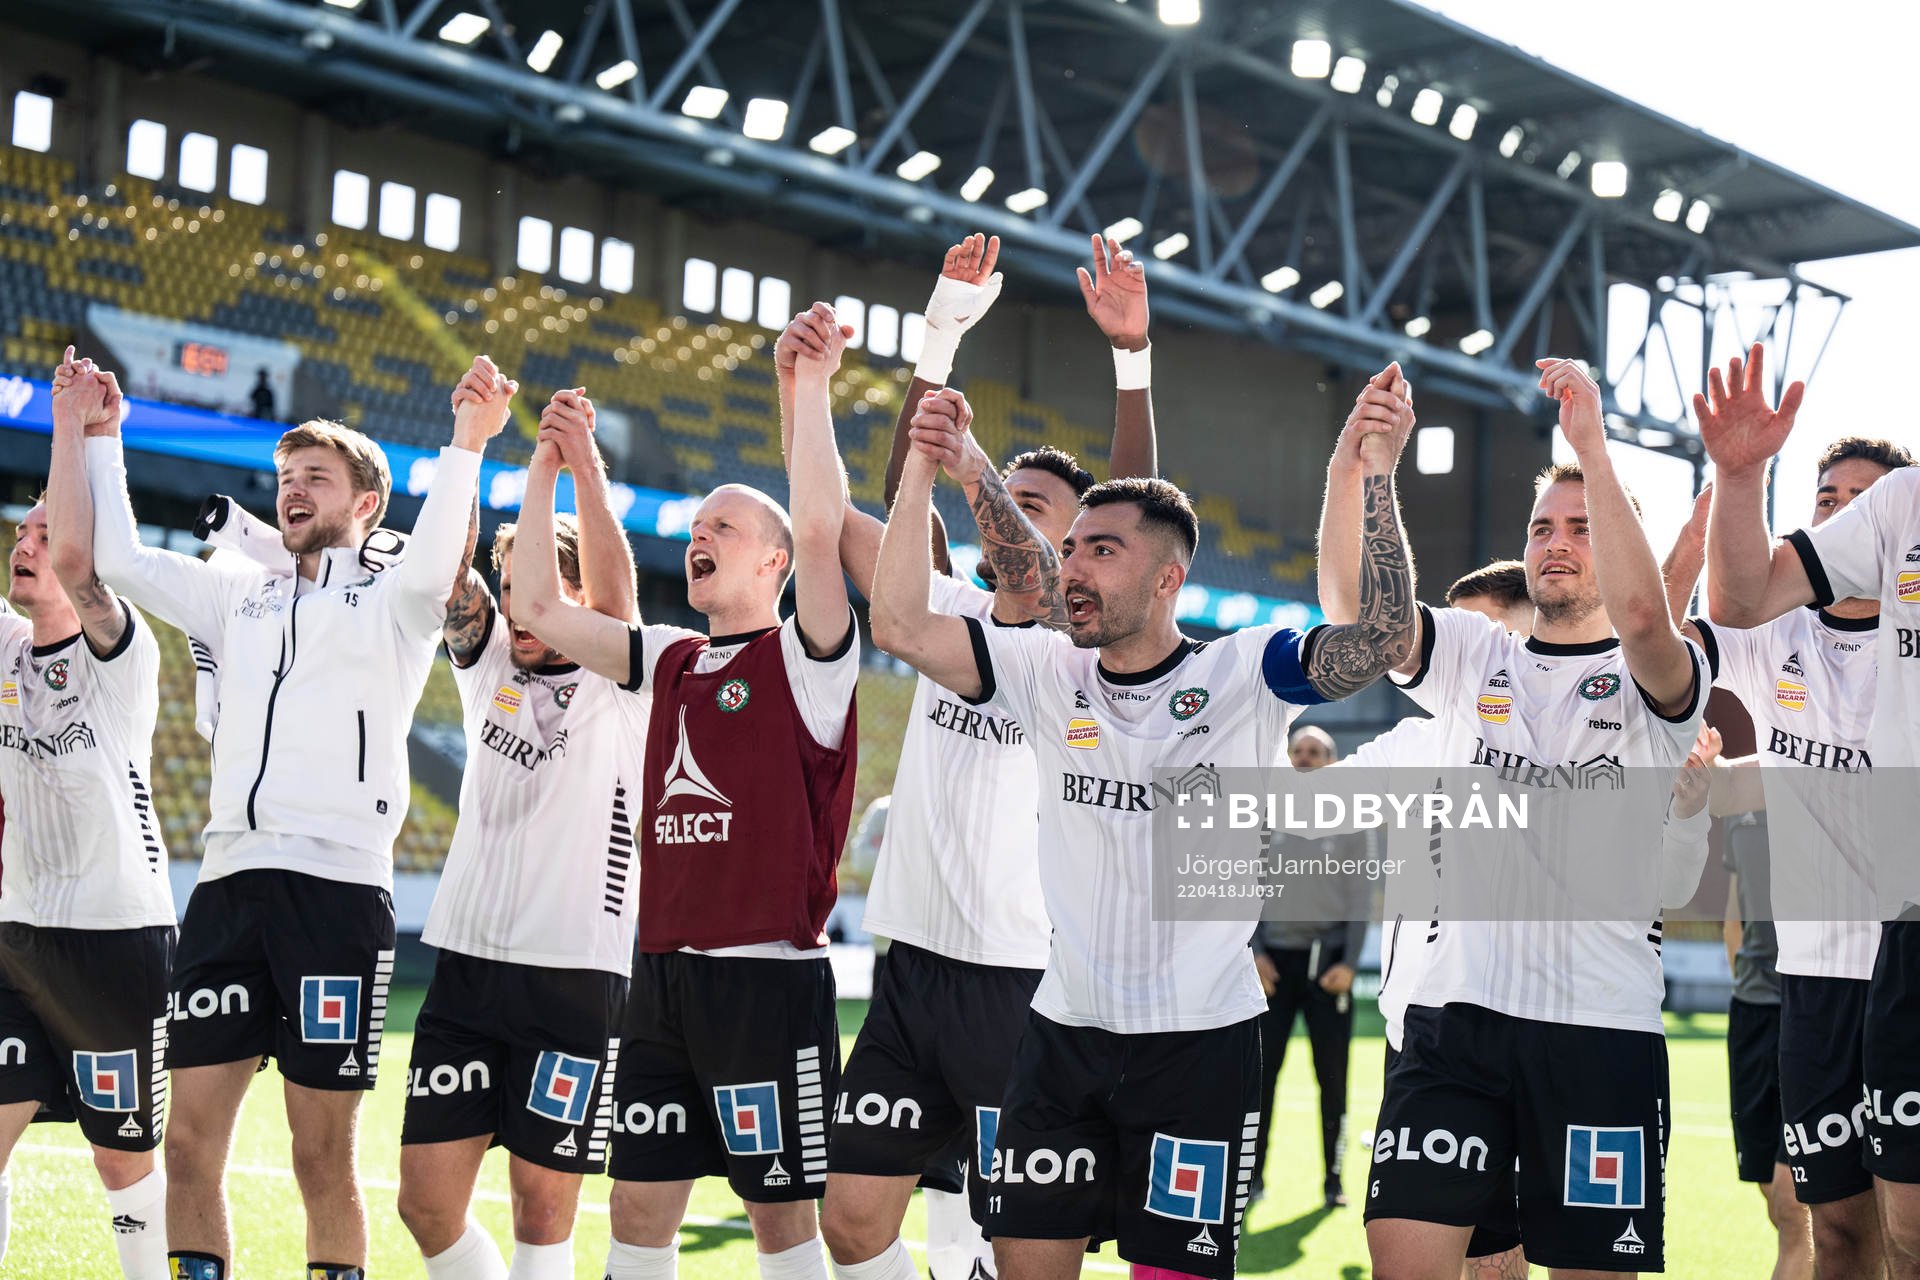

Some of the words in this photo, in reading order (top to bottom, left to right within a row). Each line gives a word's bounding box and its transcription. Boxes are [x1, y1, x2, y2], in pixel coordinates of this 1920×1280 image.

[344, 592, 359, 607] 15
[1067, 731, 1099, 741] BAGARN
[1062, 771, 1177, 812] BEHRN
[655, 812, 733, 845] SELECT
[763, 1176, 791, 1186] SELECT
[1792, 1166, 1808, 1183] 22
[1371, 1179, 1380, 1198] 6
[988, 1195, 1002, 1214] 11
[1186, 1243, 1219, 1257] SELECT
[1612, 1243, 1645, 1255] SELECT
